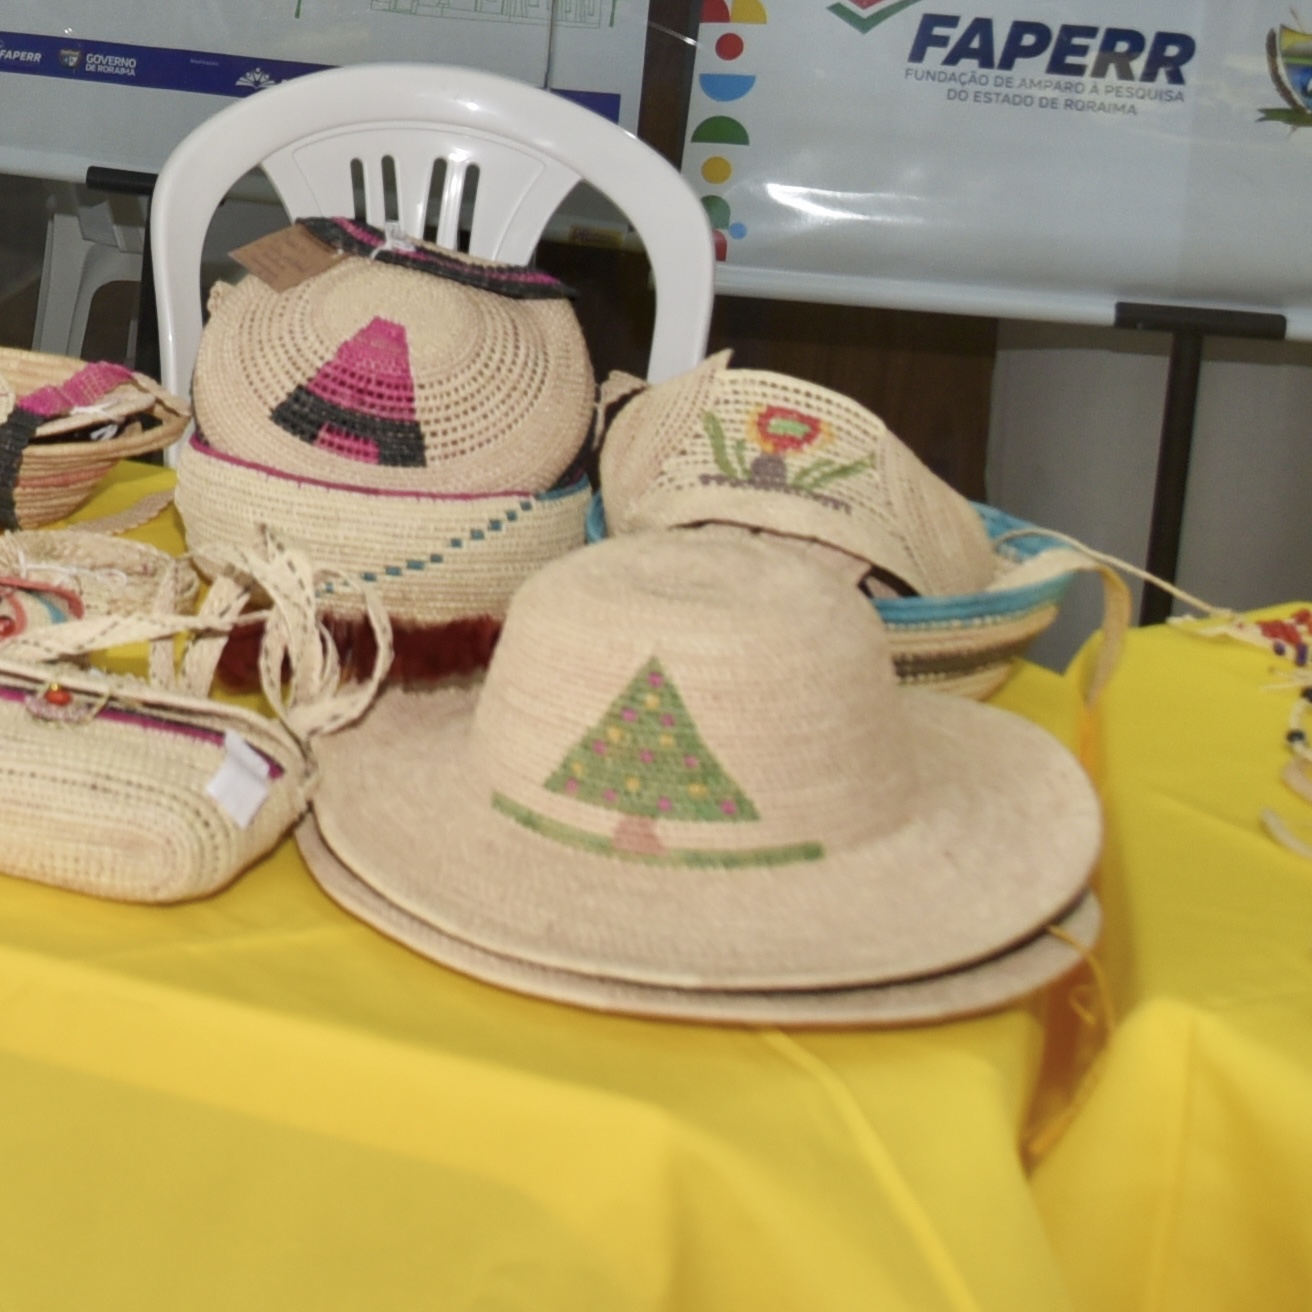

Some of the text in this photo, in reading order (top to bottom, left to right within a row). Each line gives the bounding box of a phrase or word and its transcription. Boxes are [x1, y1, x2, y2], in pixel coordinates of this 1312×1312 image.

[86, 53, 137, 68] GOVERNO
[907, 13, 1197, 86] FAPERR
[85, 63, 136, 77] DE RORAIMA
[904, 67, 989, 88] FUNDAÇÃO
[993, 75, 1014, 89] DE
[1019, 78, 1084, 95] AMPARO
[1104, 84, 1186, 103] PESQUISA
[946, 88, 1138, 117] DO ESTADO DE RORAIMA
